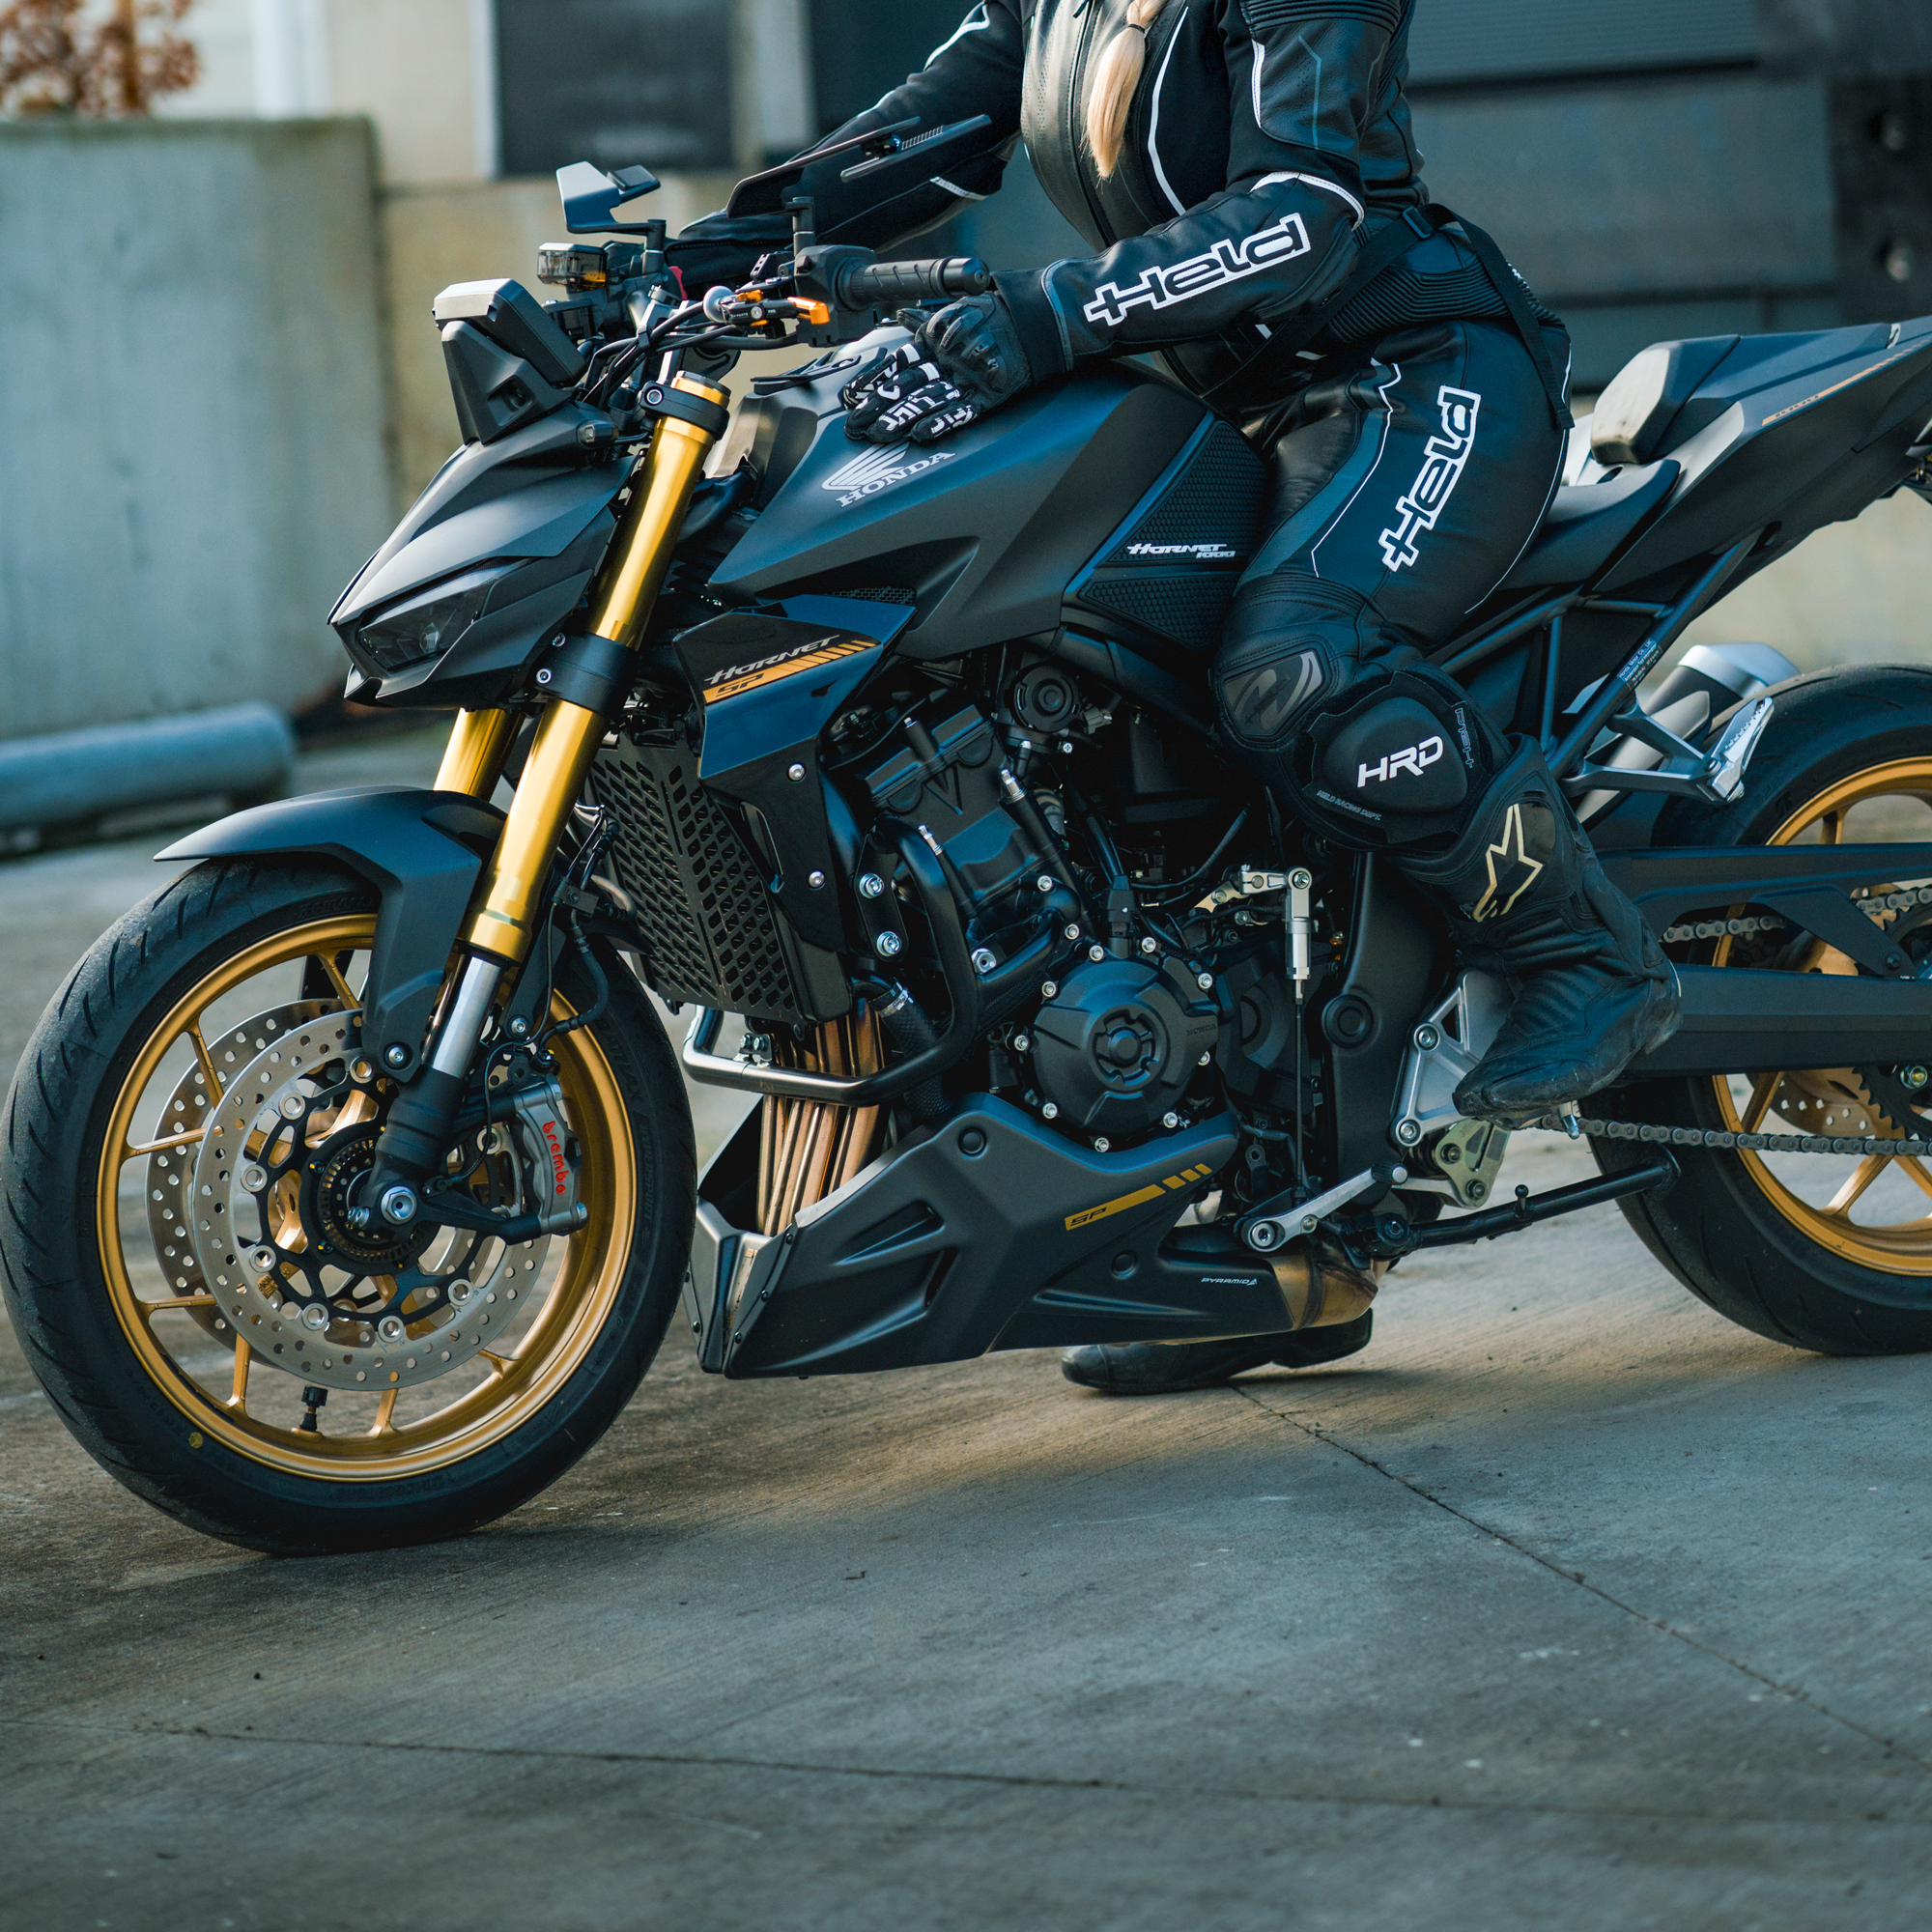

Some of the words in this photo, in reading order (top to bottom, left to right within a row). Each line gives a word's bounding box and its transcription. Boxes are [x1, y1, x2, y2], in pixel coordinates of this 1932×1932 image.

[1084, 212, 1311, 327] Held
[836, 452, 955, 507] HONDA
[1378, 384, 1481, 572] Held
[715, 672, 764, 697] SP
[1357, 736, 1443, 788] HRD
[543, 1121, 570, 1195] brembo
[1070, 1207, 1107, 1227] SP
